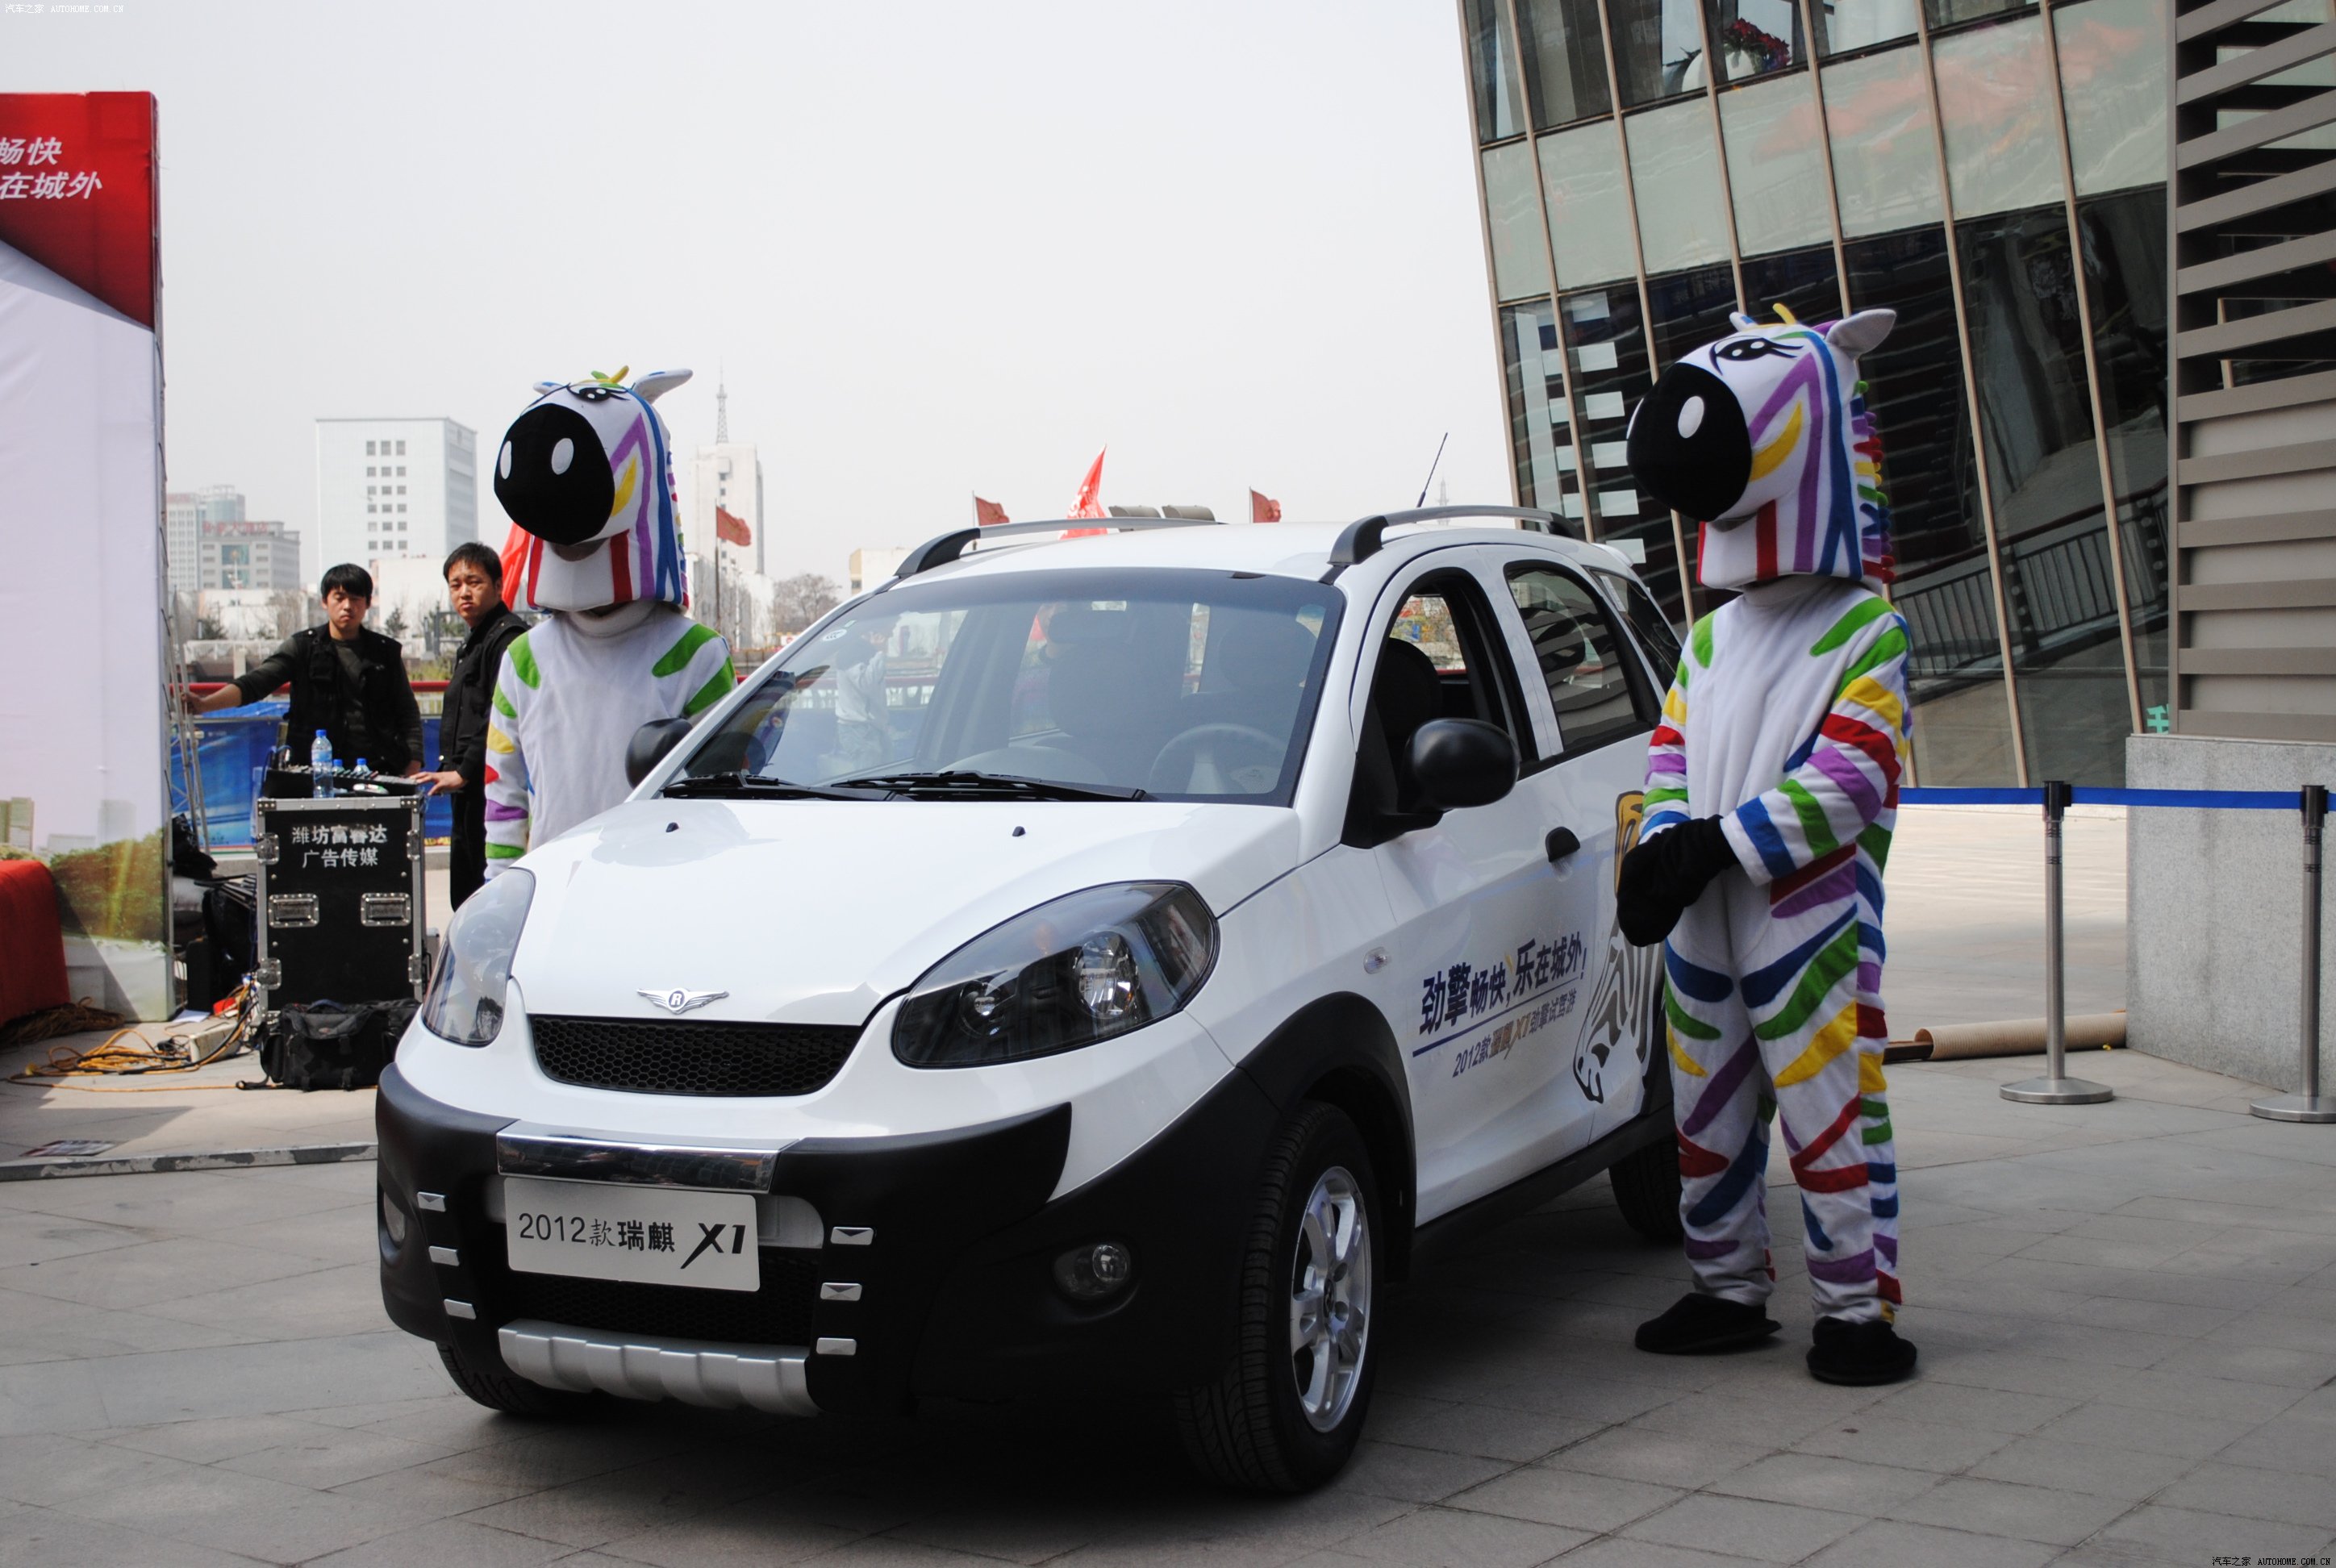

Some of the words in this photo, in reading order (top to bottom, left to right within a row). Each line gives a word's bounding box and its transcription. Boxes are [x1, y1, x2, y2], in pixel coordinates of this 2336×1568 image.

[0, 136, 62, 166] 畅快
[0, 170, 103, 200] 在城外
[302, 847, 379, 869] 广告传媒
[518, 1212, 676, 1253] 2012款瑞麒
[680, 1222, 747, 1270] X1
